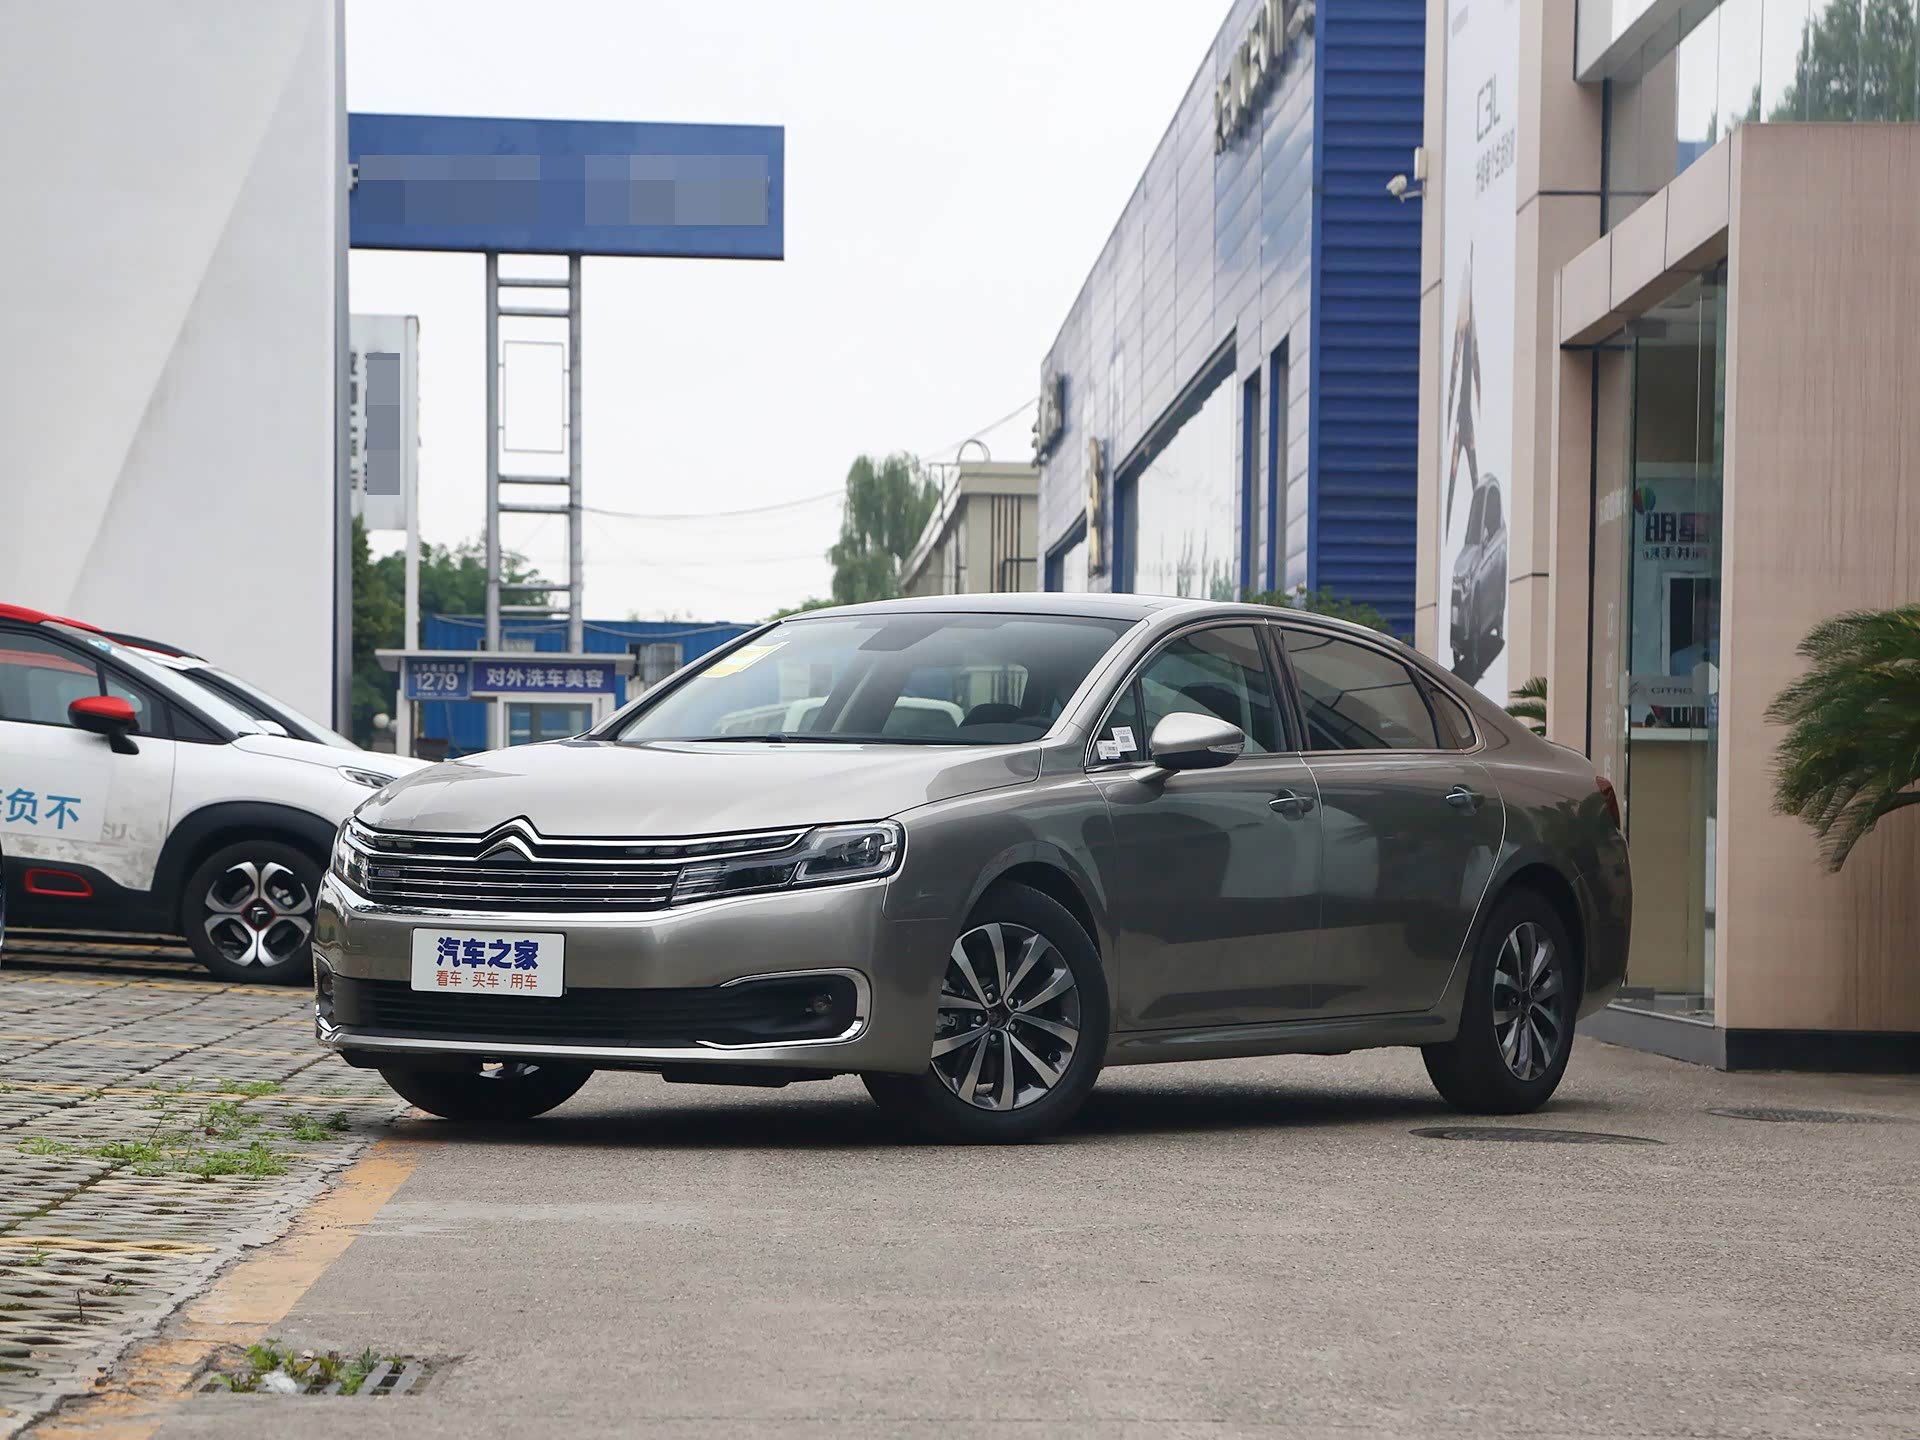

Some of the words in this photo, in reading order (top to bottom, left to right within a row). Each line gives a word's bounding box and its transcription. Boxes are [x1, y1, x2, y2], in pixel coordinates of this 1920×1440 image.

[414, 672, 459, 691] 1279
[486, 668, 604, 688] 对外洗车美容
[0, 788, 81, 829] 负不
[436, 936, 539, 970] 汽车之家
